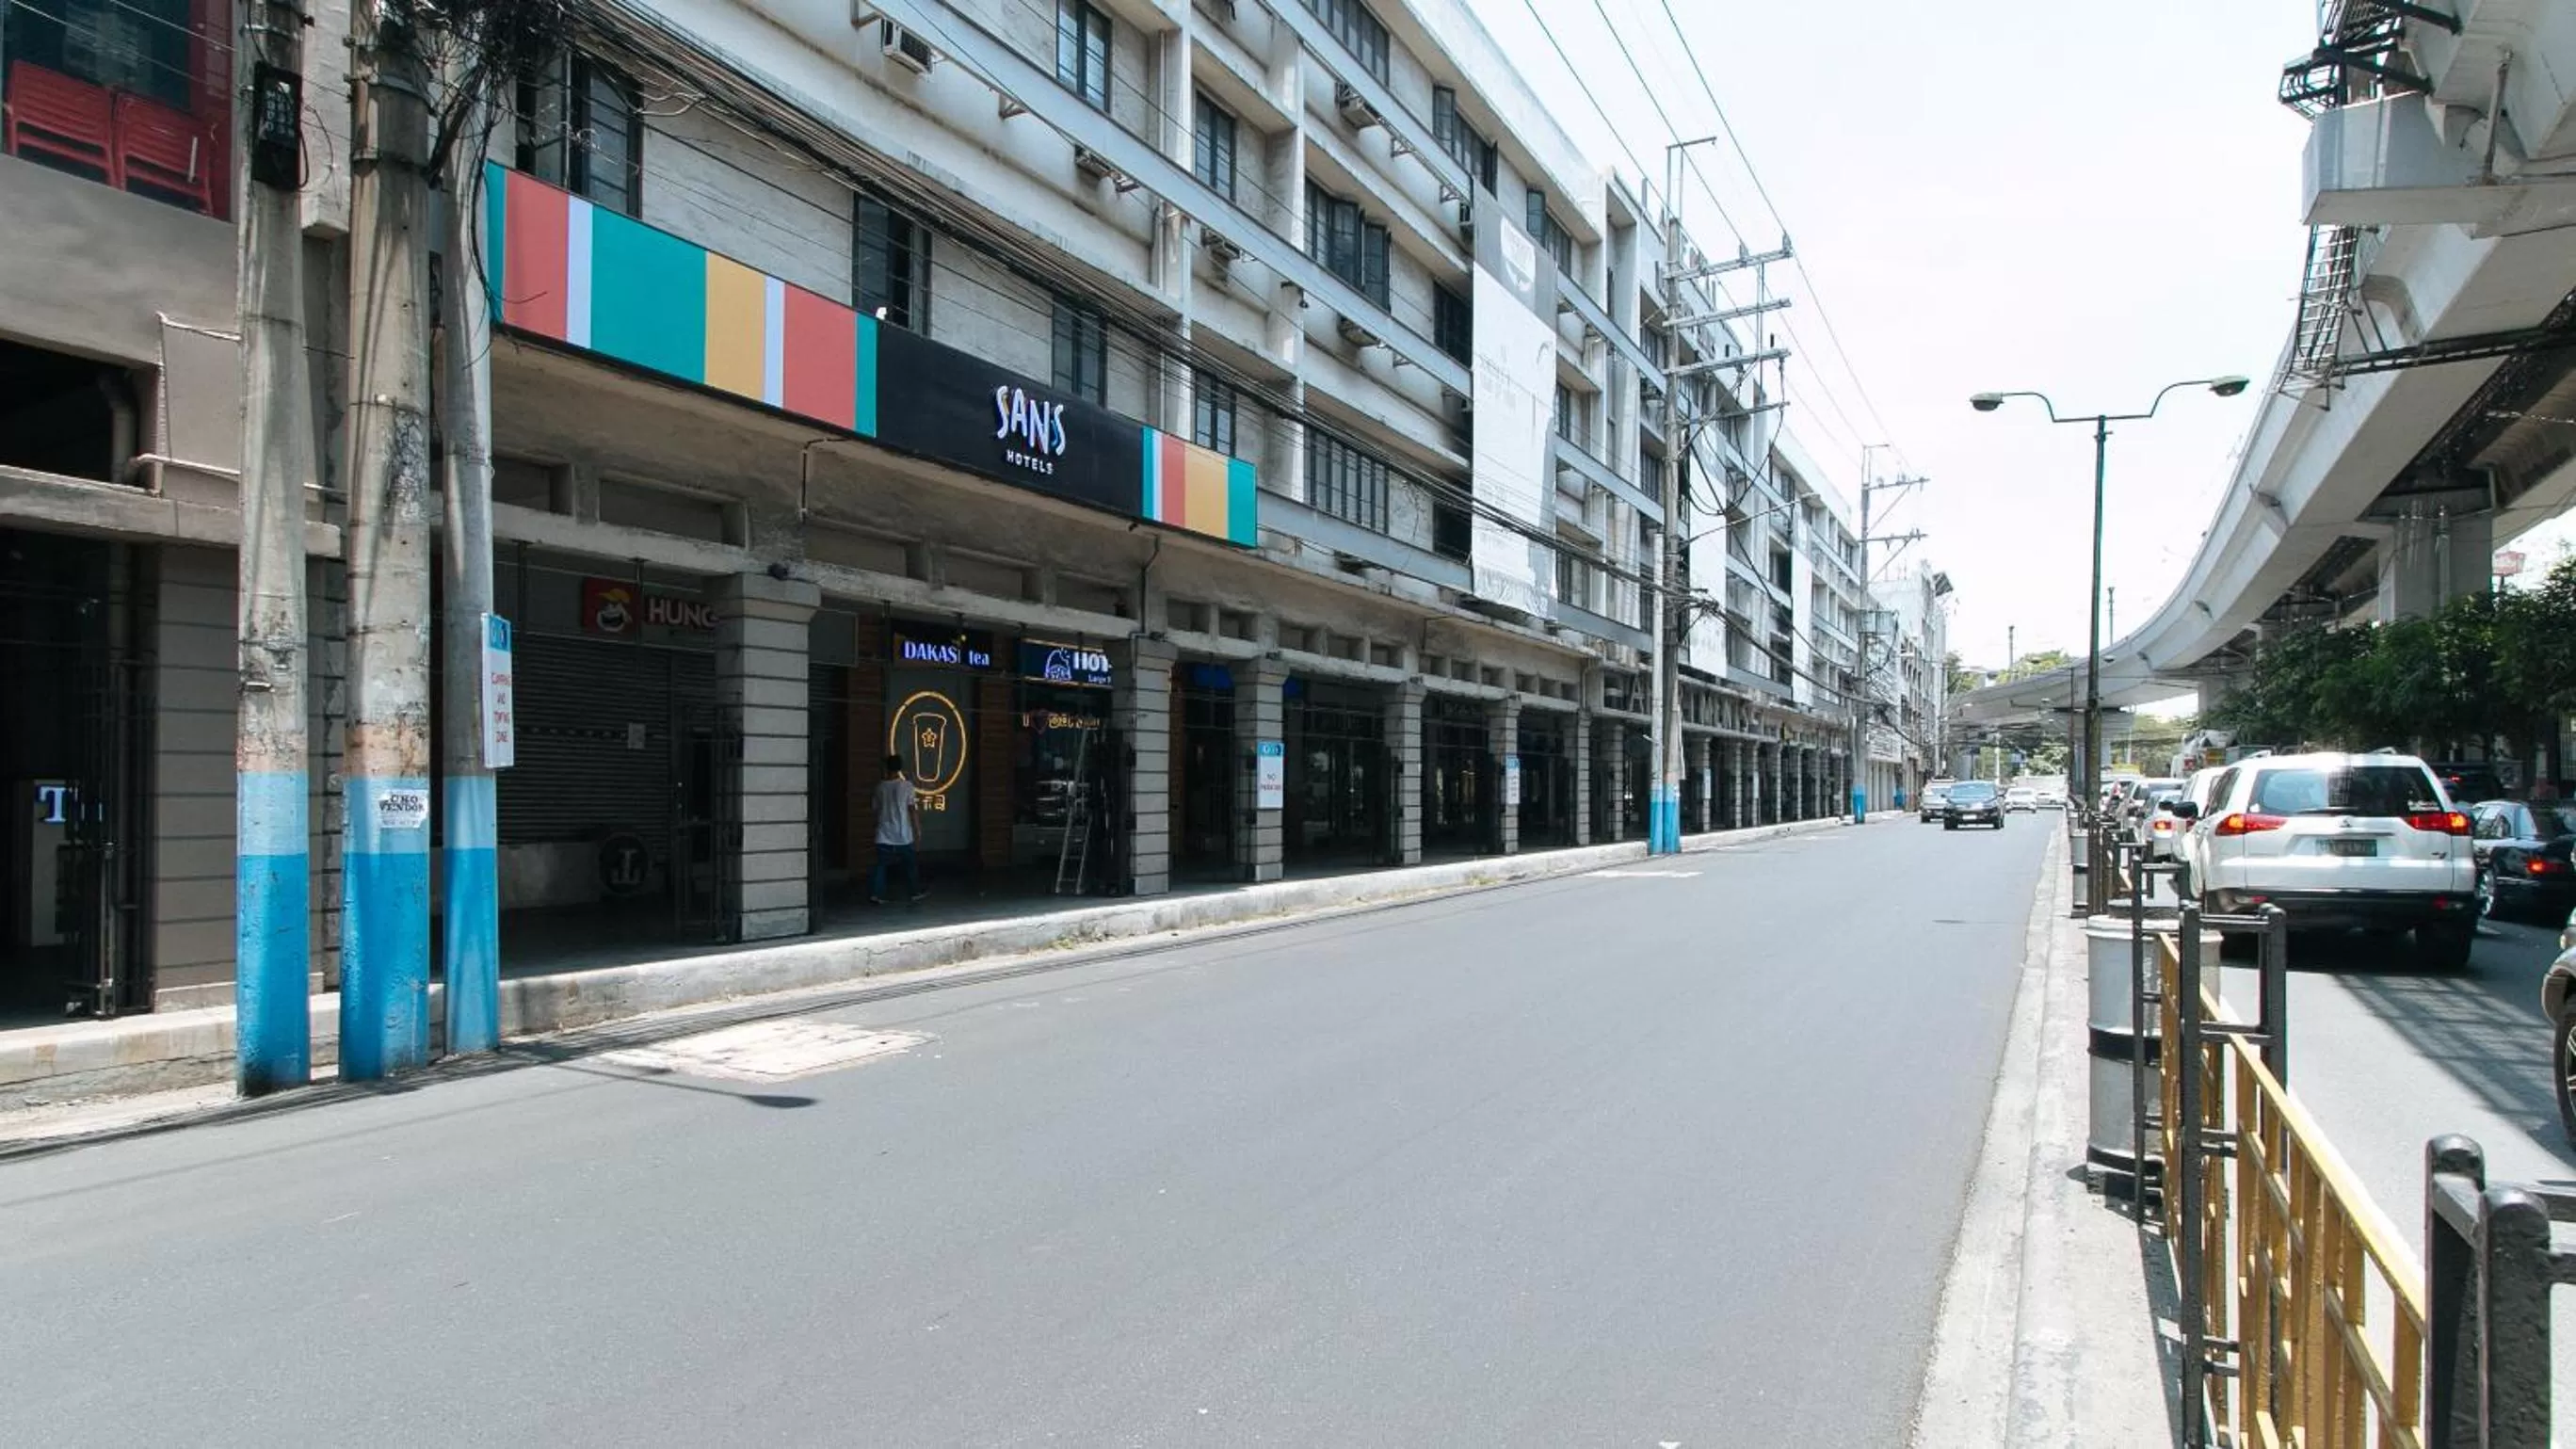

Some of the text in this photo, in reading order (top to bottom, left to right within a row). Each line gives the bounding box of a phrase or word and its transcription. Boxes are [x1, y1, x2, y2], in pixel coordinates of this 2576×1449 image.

[996, 385, 1066, 456] SANS
[1006, 449, 1055, 475] HOTELS
[968, 650, 990, 667] tea
